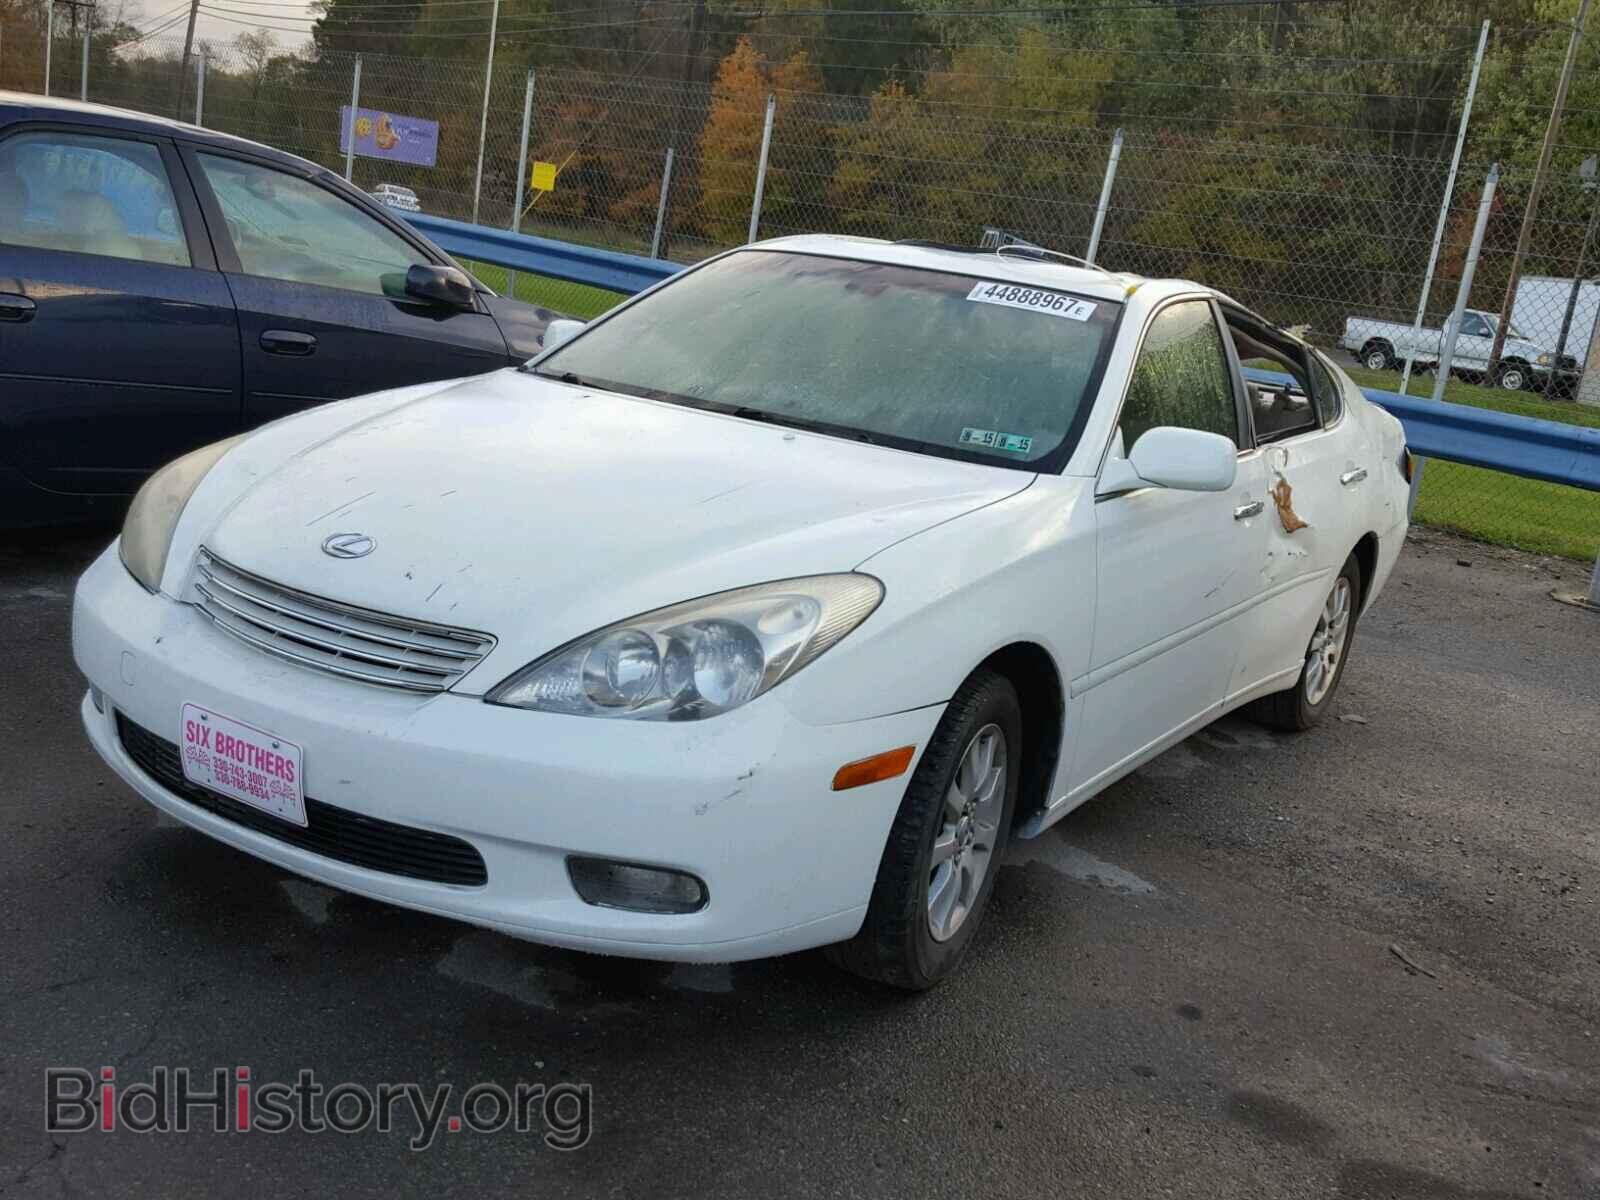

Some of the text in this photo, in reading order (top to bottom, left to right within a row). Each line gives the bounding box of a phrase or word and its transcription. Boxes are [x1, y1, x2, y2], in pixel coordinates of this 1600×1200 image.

[984, 284, 1079, 313] 44888967
[186, 719, 295, 783] SIX BROTHERS
